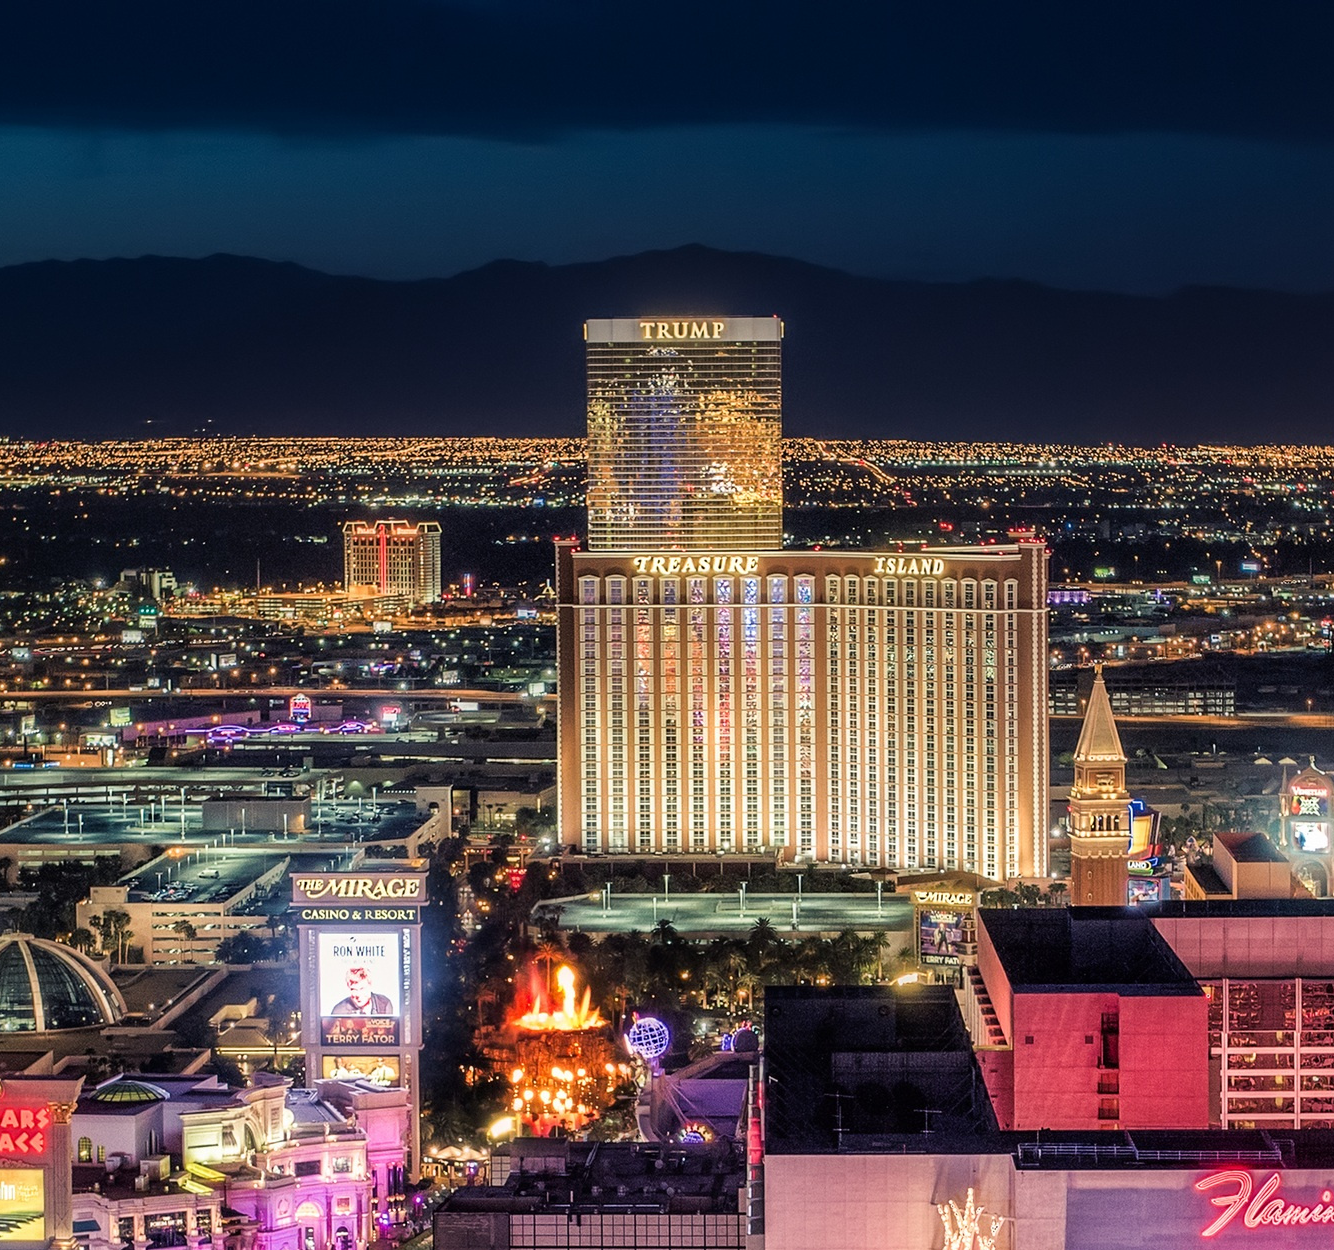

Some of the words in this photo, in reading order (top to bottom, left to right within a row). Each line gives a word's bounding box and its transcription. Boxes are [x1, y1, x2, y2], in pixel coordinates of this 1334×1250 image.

[640, 321, 725, 340] TRUMP
[633, 555, 759, 576] TREASURE
[874, 556, 944, 576] ISLAND
[296, 879, 324, 892] THE
[307, 879, 420, 899] MIRAGE
[919, 892, 973, 904] MIRAGE
[302, 909, 349, 921] CASINO
[352, 909, 362, 920] &
[365, 909, 416, 921] RESORT
[333, 946, 353, 957] RON
[356, 946, 385, 957] WHITE
[921, 956, 944, 965] TERRY
[326, 1034, 359, 1043] TERRY
[362, 1034, 395, 1043] FATOR
